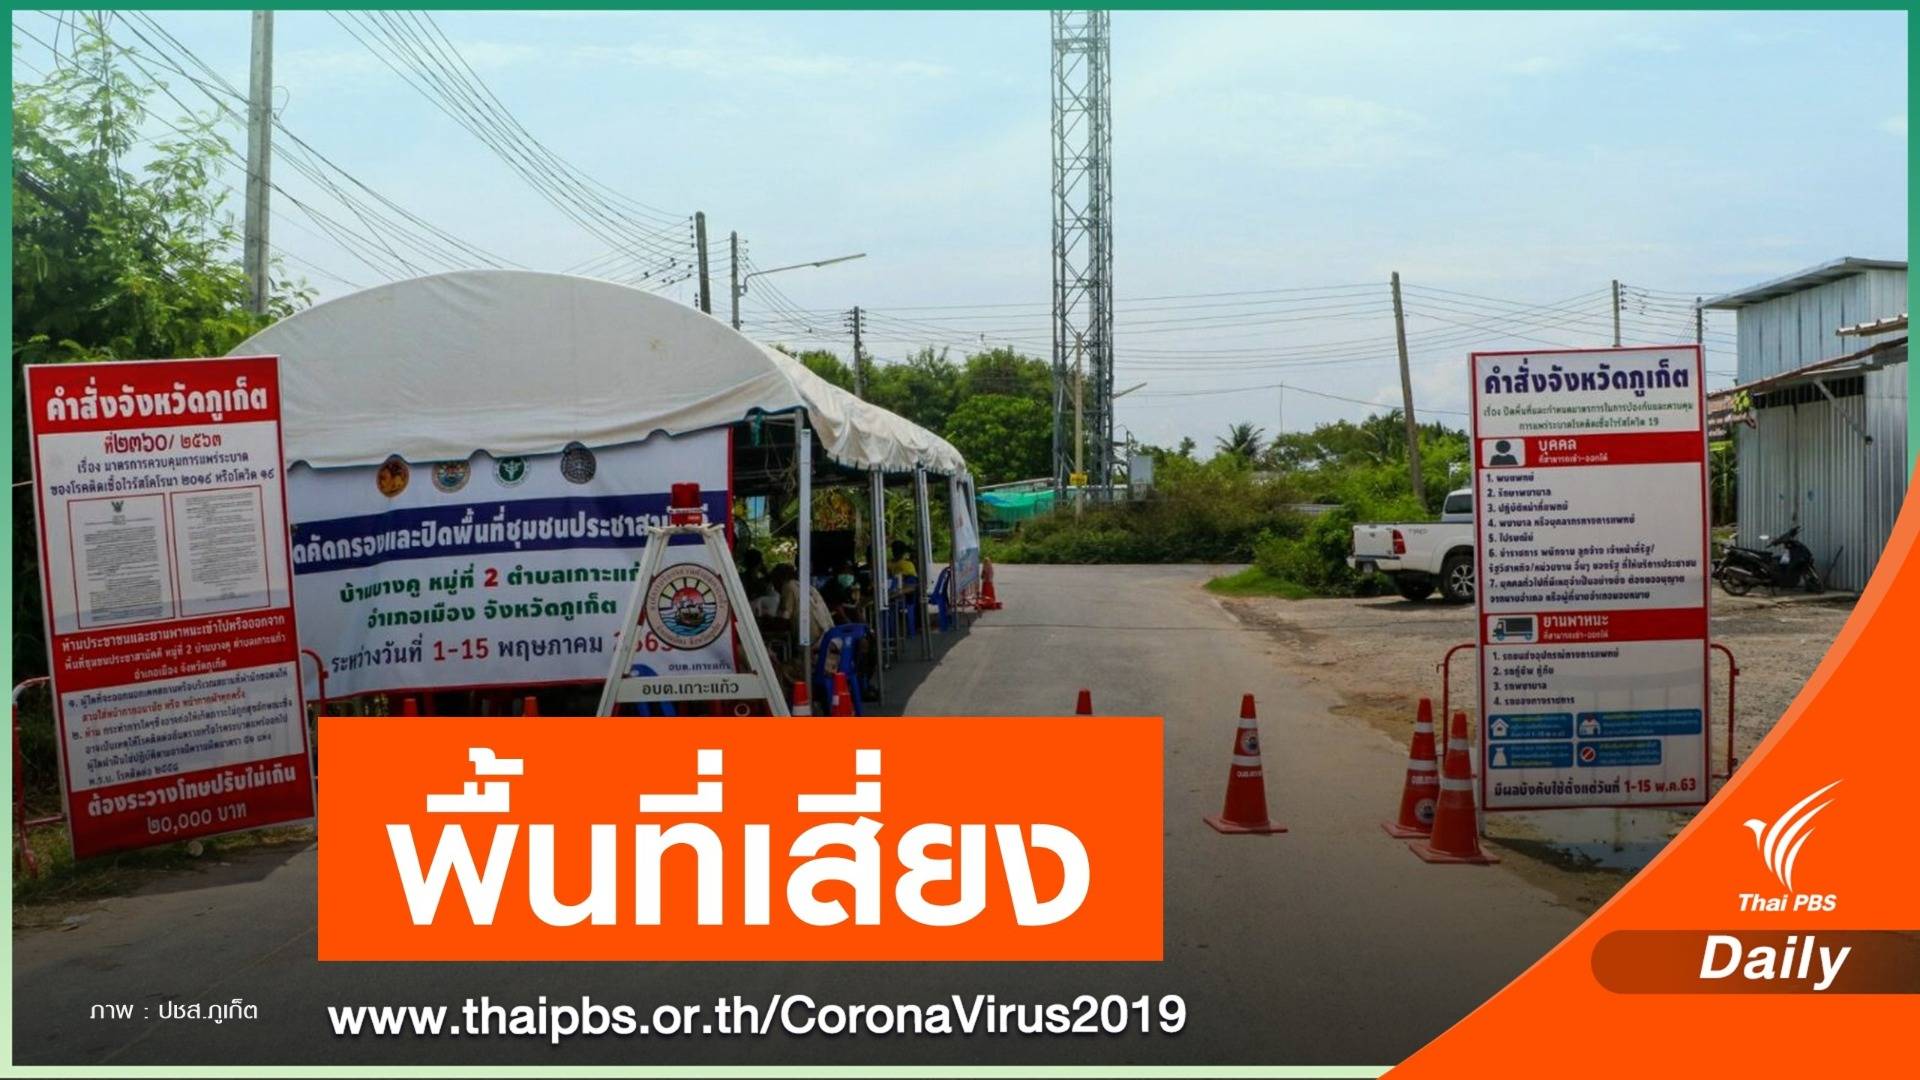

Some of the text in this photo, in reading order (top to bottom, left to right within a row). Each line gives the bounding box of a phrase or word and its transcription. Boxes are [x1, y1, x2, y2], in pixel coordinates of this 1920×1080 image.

[1485, 358, 1688, 397] คำสั่งจังหวัดภูเก็ต
[47, 377, 267, 421] คำสั่งจังหวัดภูเก็ต
[1649, 417, 1659, 426] 19
[180, 432, 222, 448] ๒๕๖๓
[1539, 438, 1577, 455] บุคคล
[78, 450, 249, 474] เรื่อง มาตรการควบคุมการแพร่ระบาด
[340, 577, 420, 604] บ้านบางคู
[429, 563, 475, 593] หมู่ที่
[484, 567, 499, 588] 2
[368, 592, 617, 629] อำเภอเมือง จังหวัดภูเก็ต
[1543, 614, 1609, 628] ยานพาหนะ
[186, 644, 193, 655] 2
[331, 634, 424, 673] ระหว่างวันที่
[433, 638, 489, 661] 1-15
[498, 633, 602, 668] พฤษภาคม
[642, 679, 740, 696] อบต.เกาะแก้ว
[88, 762, 296, 816] ต้องระวางโทษปรับไม่เกิน
[1624, 780, 1651, 794] 1-15
[1654, 777, 1697, 793] พ.ค.63
[218, 802, 247, 821] บาท
